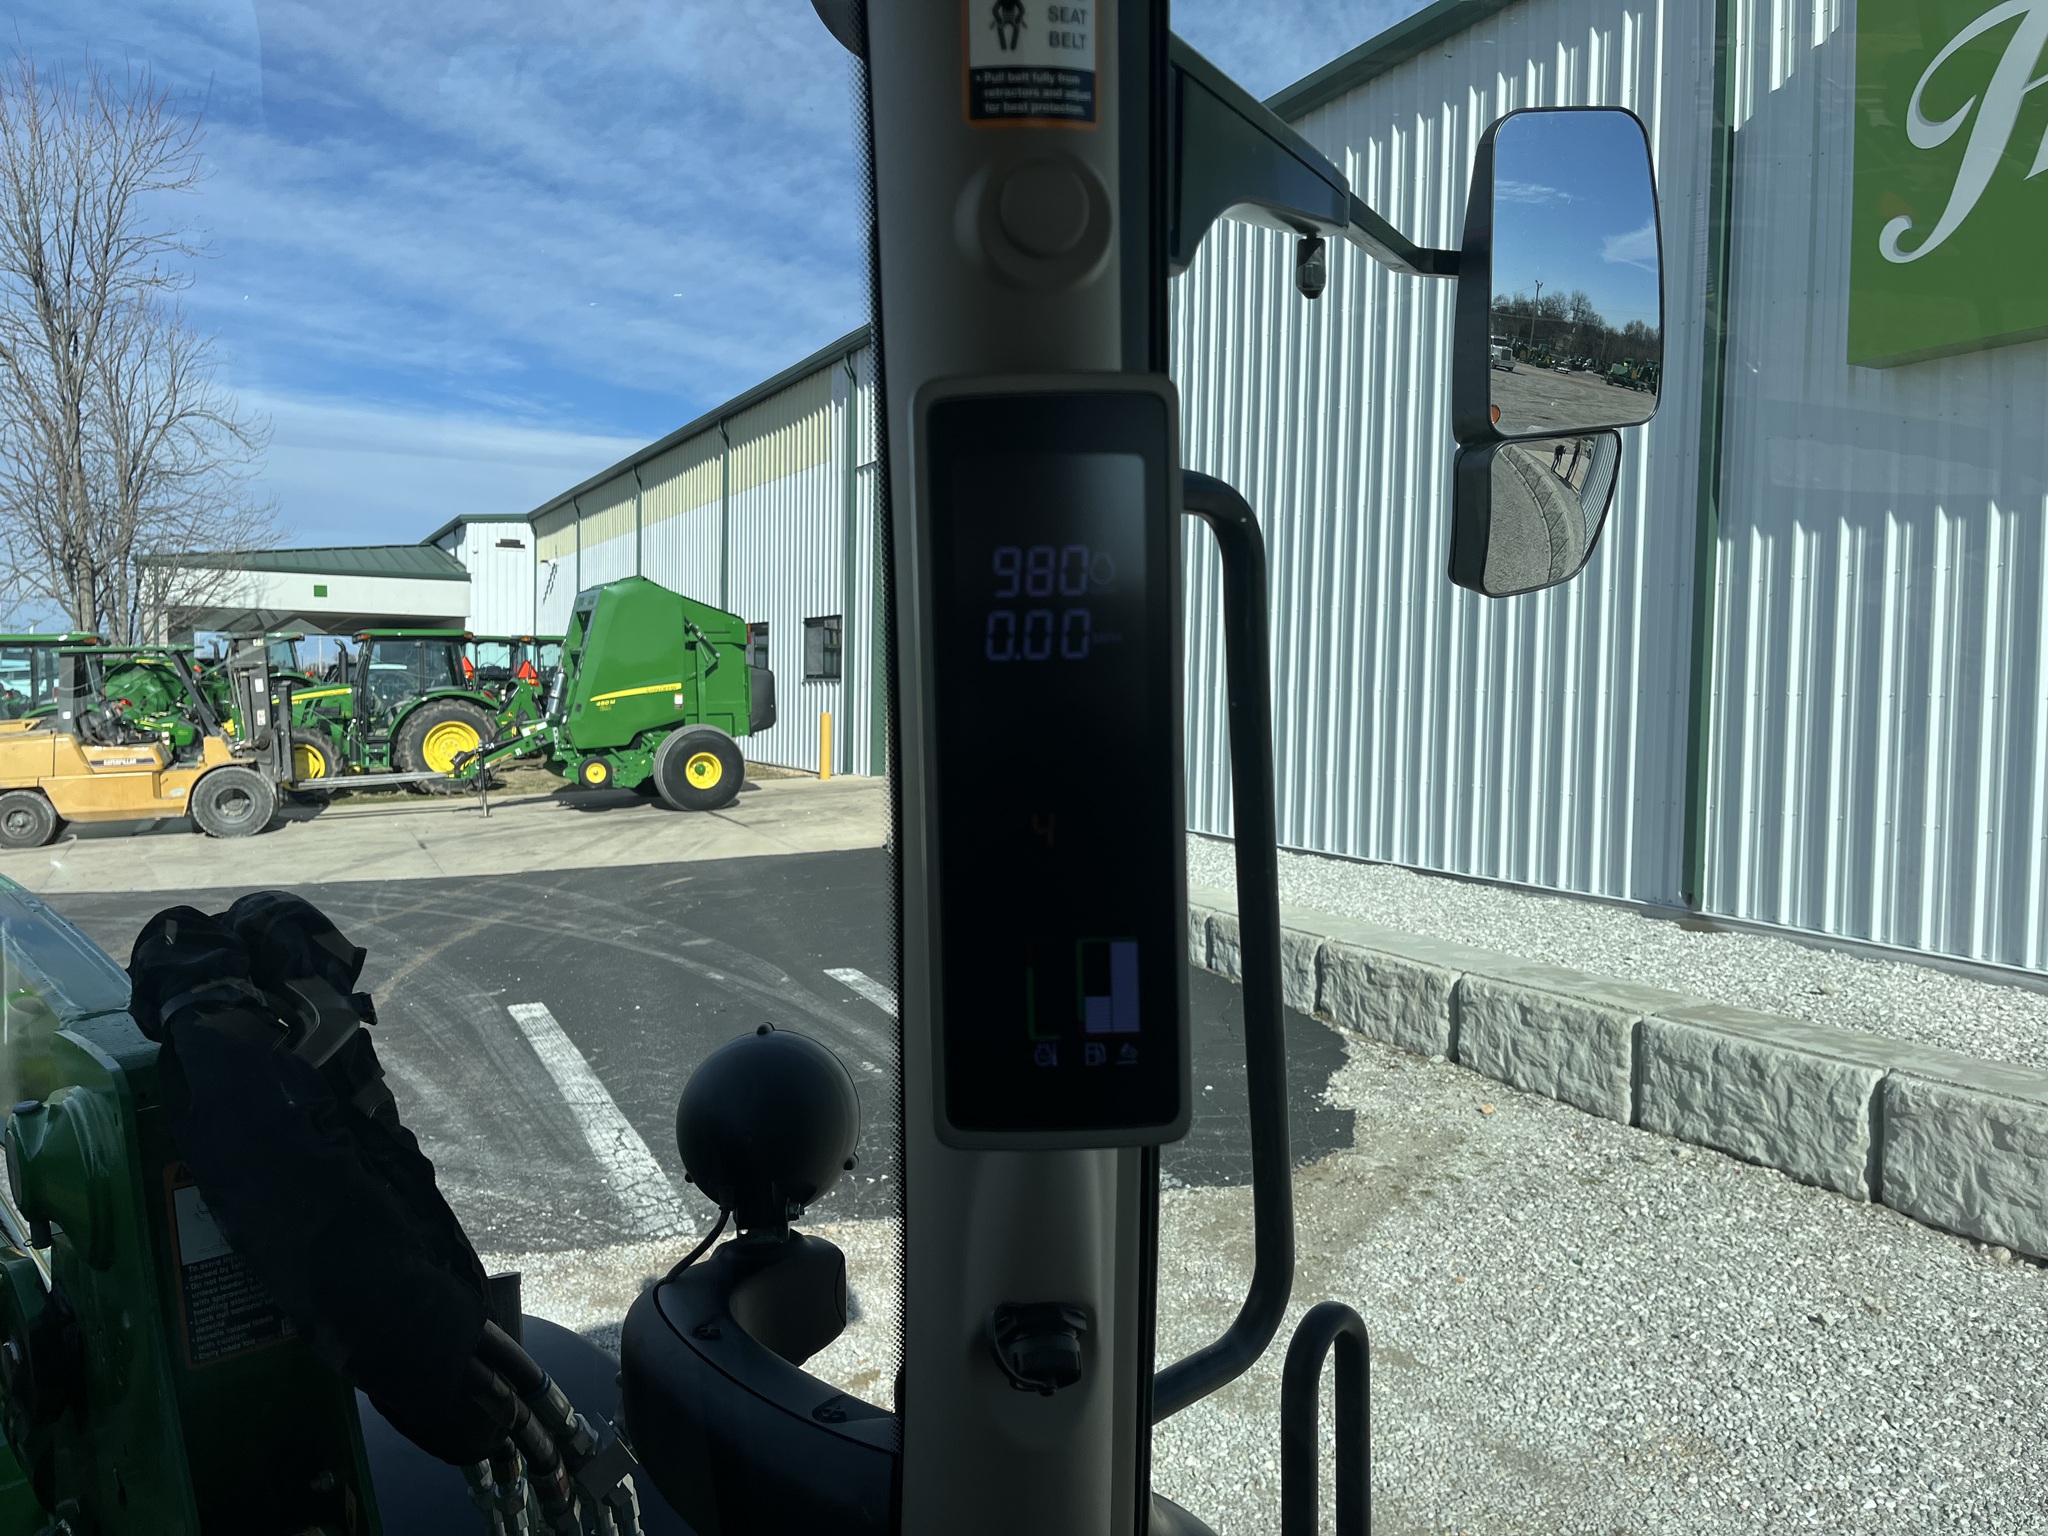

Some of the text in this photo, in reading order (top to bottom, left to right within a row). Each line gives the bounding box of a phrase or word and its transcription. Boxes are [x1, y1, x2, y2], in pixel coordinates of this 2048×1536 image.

[1048, 5, 1087, 25] SEAT
[1049, 30, 1087, 49] BELT
[984, 71, 1081, 86] Pull belt fully from
[1043, 89, 1063, 99] and
[985, 104, 1000, 113] for
[1004, 103, 1029, 114] best
[993, 545, 1089, 597] 980
[985, 609, 1091, 661] 0.00
[200, 1260, 221, 1270] avoid
[189, 1269, 218, 1282] caused
[220, 1266, 229, 1275] by
[191, 1282, 202, 1290] Do
[192, 1287, 218, 1299] unless
[220, 1280, 245, 1290] loader
[192, 1297, 209, 1307] with
[211, 1287, 248, 1302] approved
[194, 1302, 229, 1316] handling
[195, 1314, 214, 1325] Lock
[216, 1310, 229, 1319] out
[231, 1299, 262, 1315] optional
[253, 1315, 274, 1326] loads
[199, 1350, 219, 1360] Carry
[221, 1342, 241, 1353] loads
